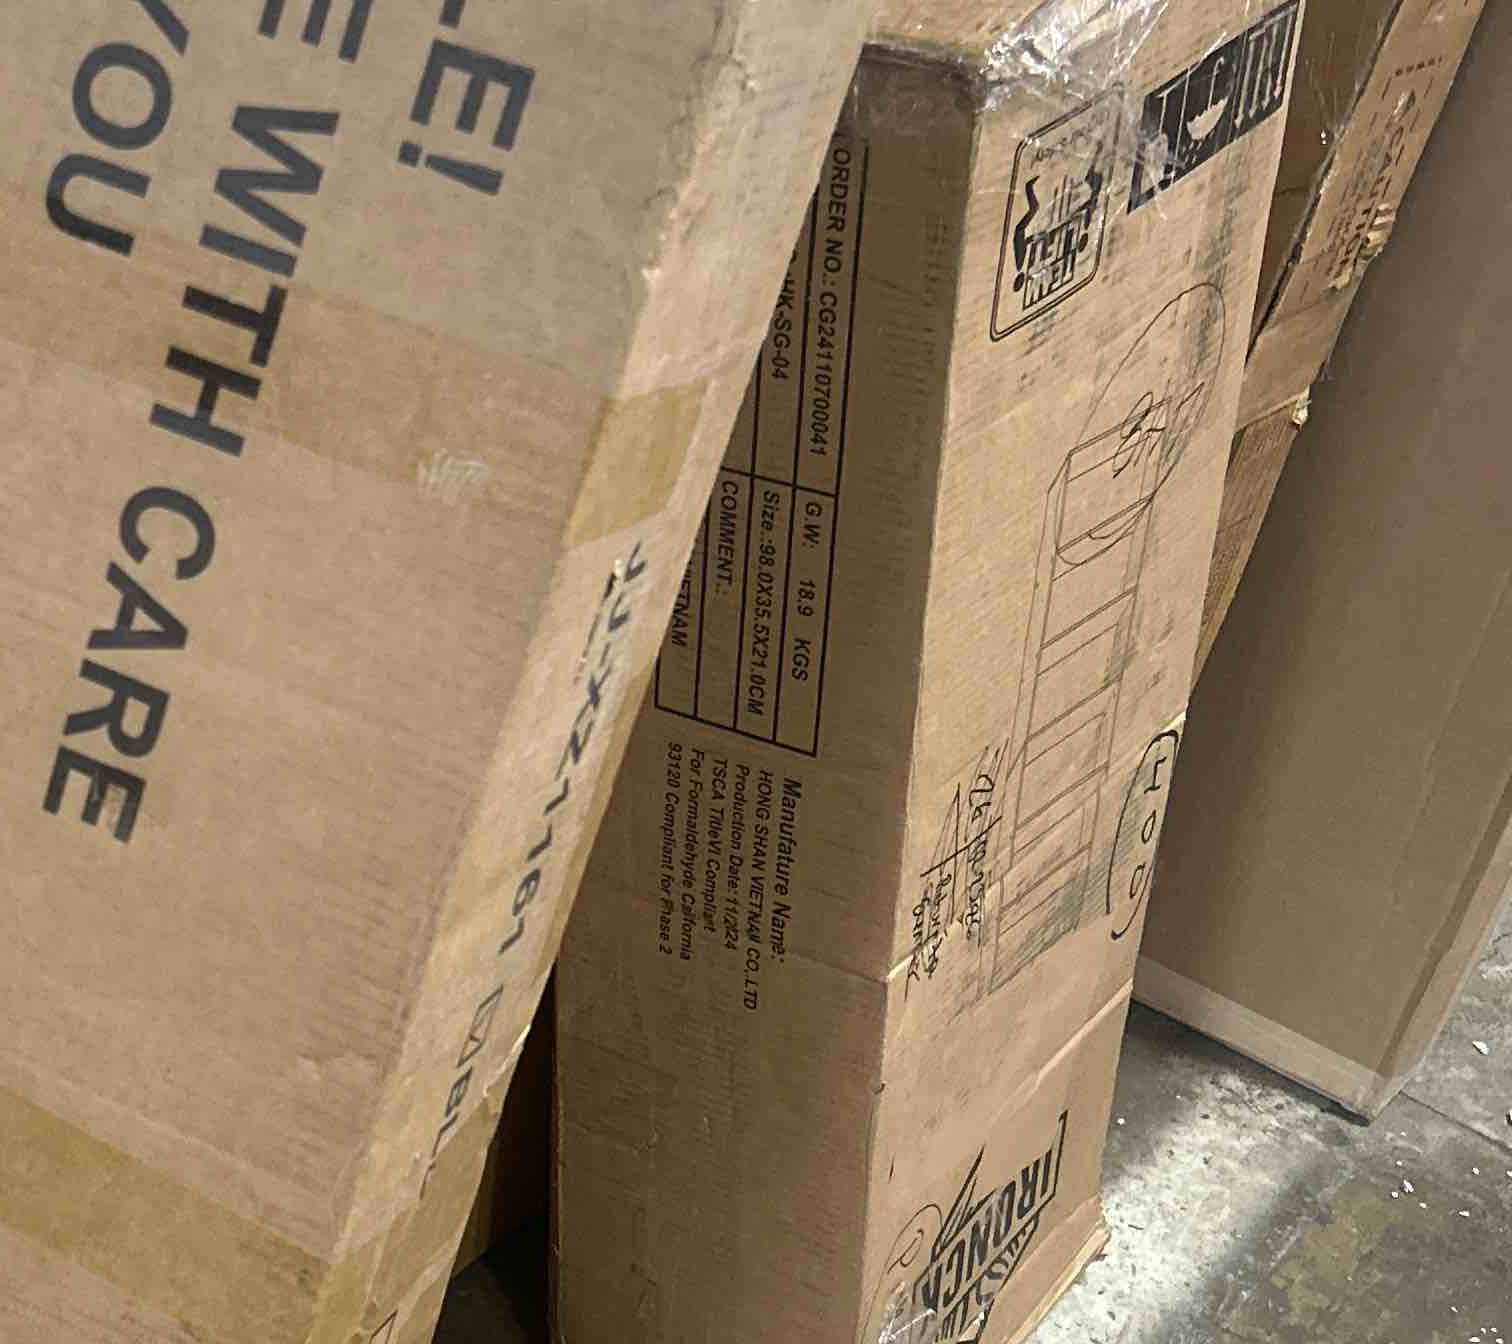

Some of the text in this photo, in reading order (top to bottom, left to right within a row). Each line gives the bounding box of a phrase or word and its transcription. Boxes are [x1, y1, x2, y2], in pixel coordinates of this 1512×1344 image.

[824, 148, 850, 231] ORDER
[150, 104, 339, 458] WITH
[809, 293, 838, 457] CG24110700041
[672, 560, 692, 646] IETNAM
[797, 580, 817, 617] 18.9
[41, 484, 219, 844] CARE
[792, 638, 811, 681] KGS
[666, 740, 681, 788] 93120
[690, 748, 703, 775] For
[711, 755, 727, 803] TSCA
[729, 762, 748, 852] Production
[755, 769, 772, 821] HONG
[659, 789, 677, 872] Compliant
[681, 776, 701, 890] Formaldehyde
[752, 823, 768, 872] SHAN
[659, 872, 673, 897] for
[727, 853, 742, 895] Date:
[768, 777, 800, 962] Manufature Name:
[659, 943, 670, 954] 2
